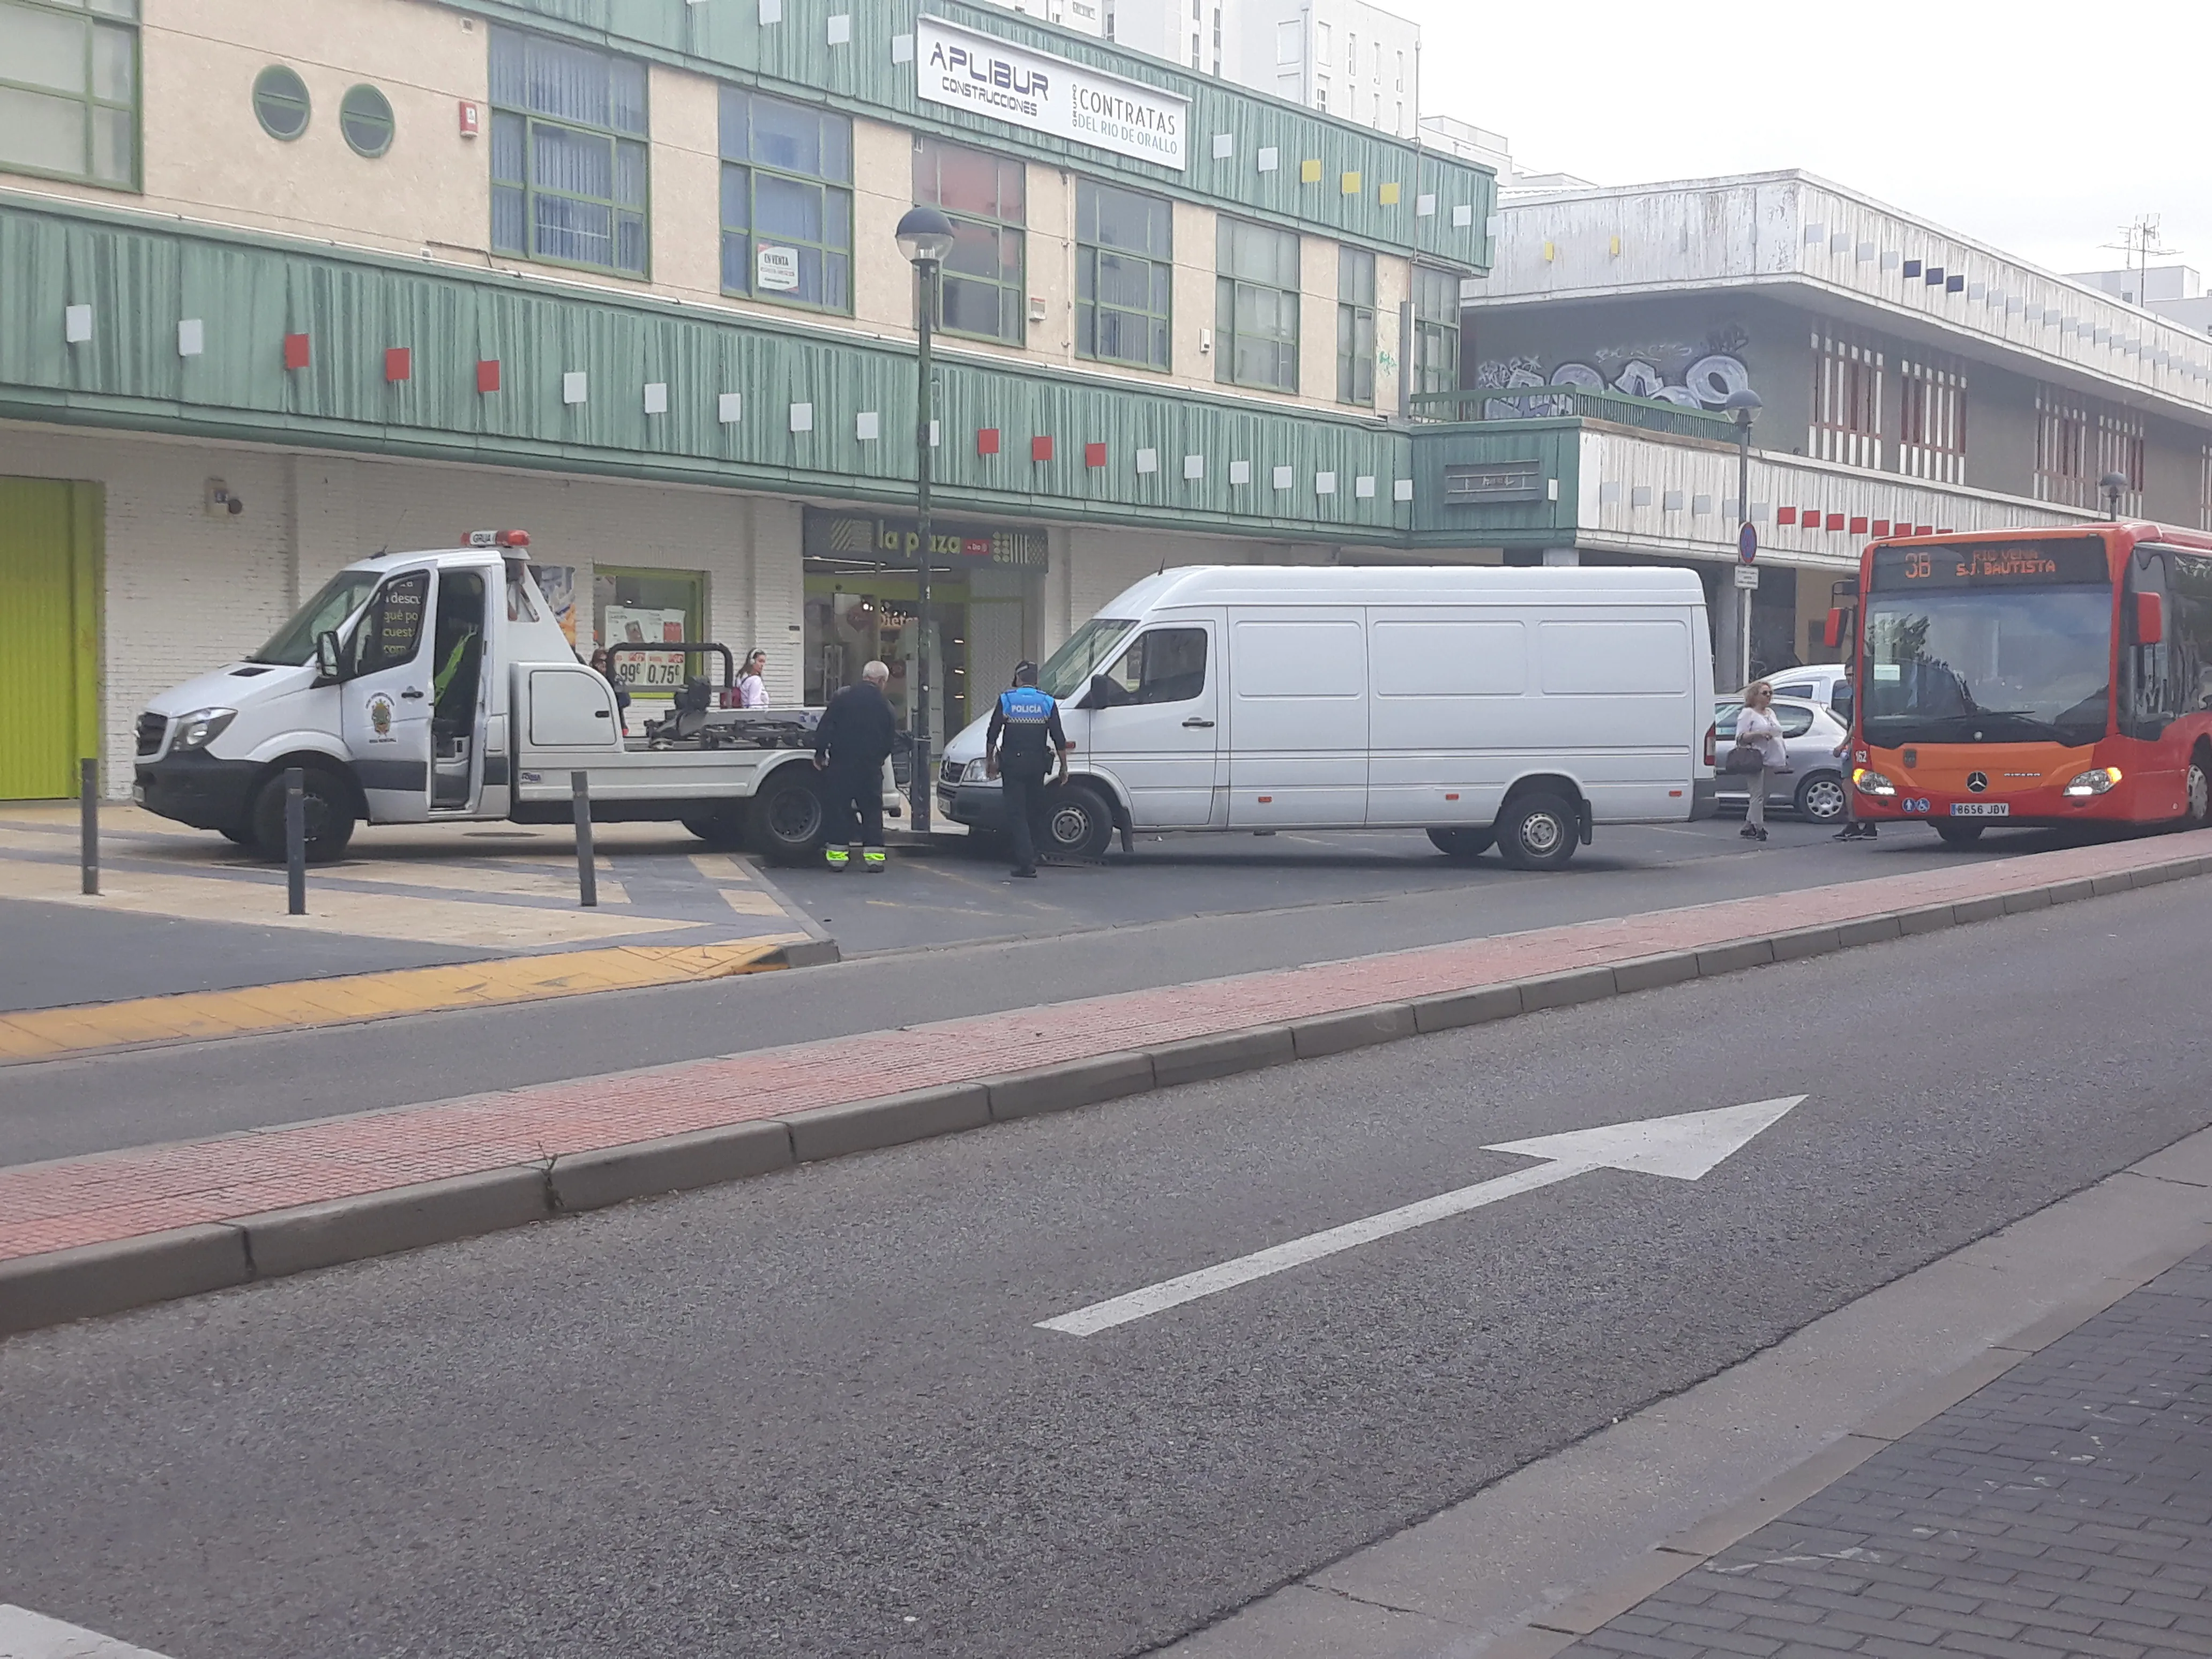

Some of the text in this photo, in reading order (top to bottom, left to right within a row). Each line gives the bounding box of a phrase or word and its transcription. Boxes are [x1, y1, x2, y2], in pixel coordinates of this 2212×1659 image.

[930, 41, 1049, 101] APLIBUR
[942, 76, 1037, 117] CONSTRUCCIONES
[1080, 88, 1175, 135] CONTRATAS
[1078, 114, 1177, 154] DEL RIO DE ORALLO
[877, 519, 898, 550] la
[1984, 559, 2056, 575] BAUTISTA
[1855, 750, 1867, 763] 162
[1957, 805, 1983, 814] 8656
